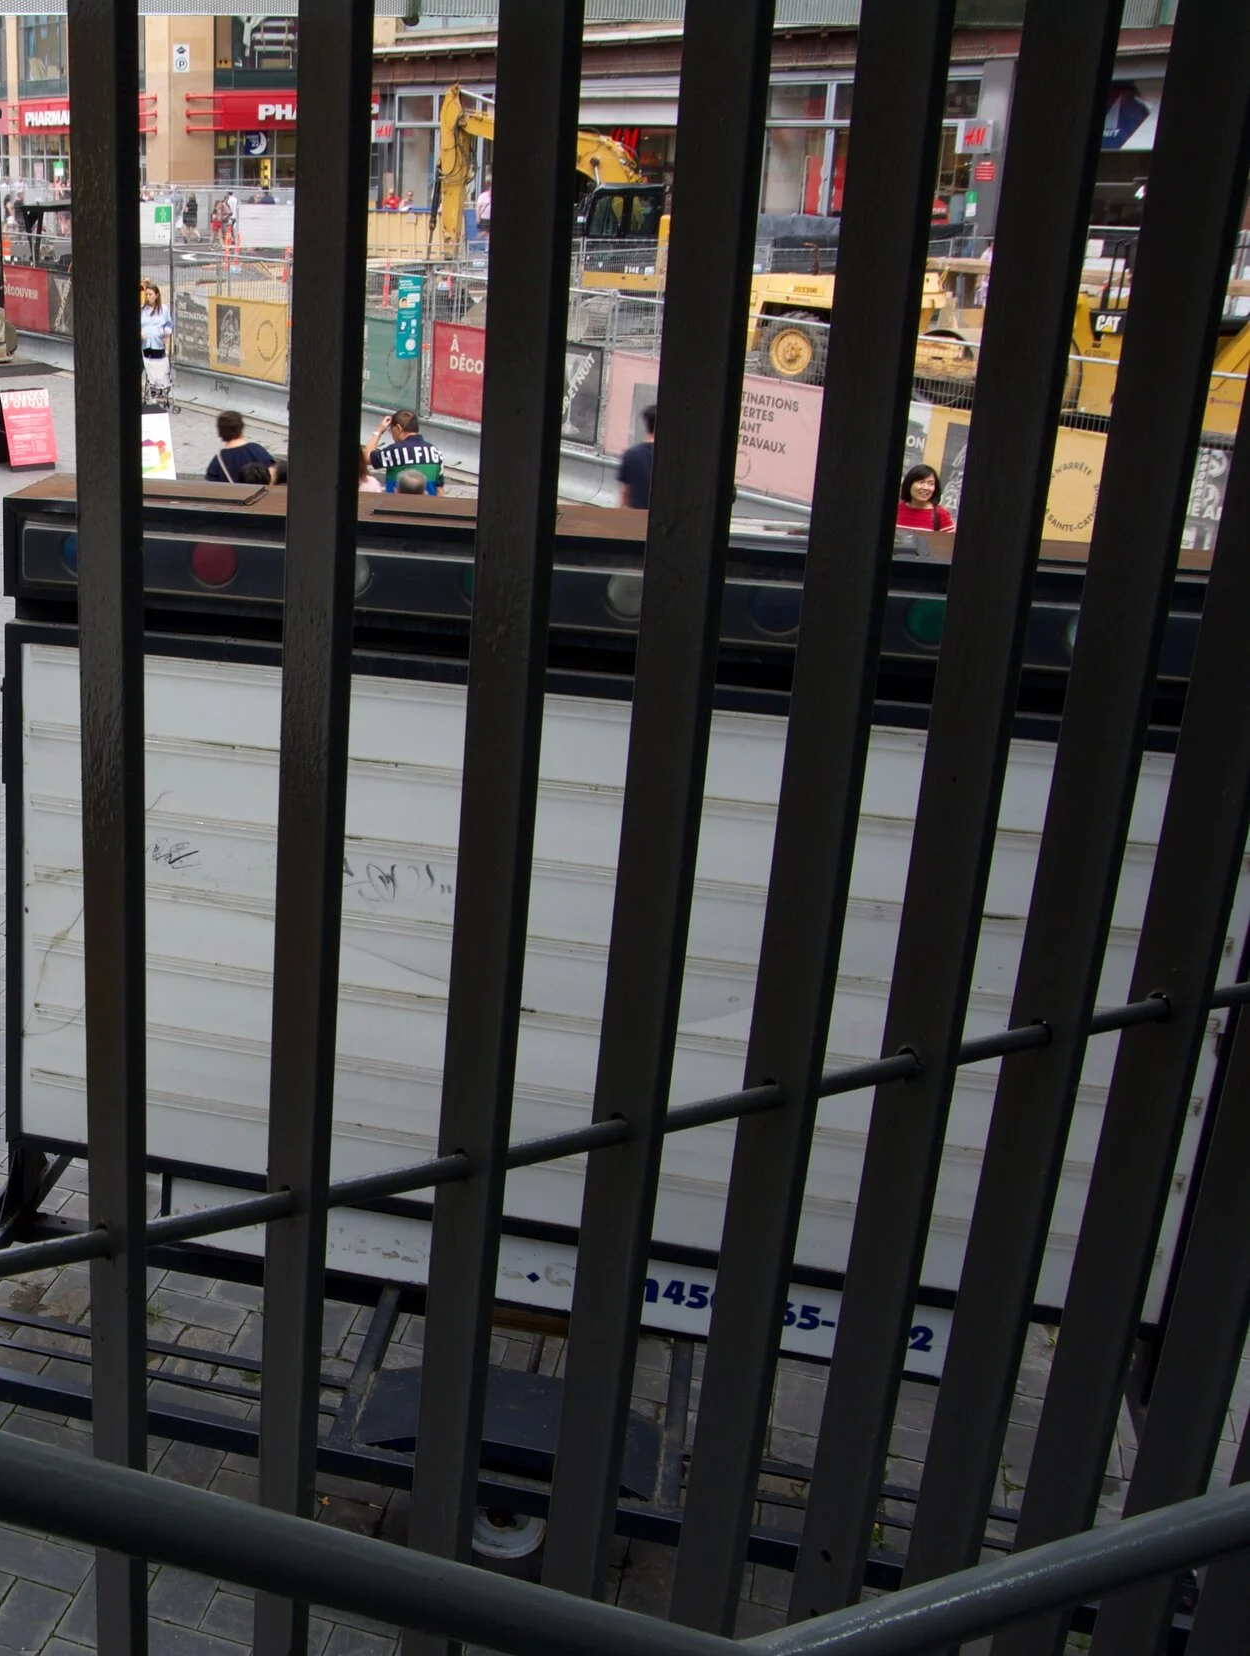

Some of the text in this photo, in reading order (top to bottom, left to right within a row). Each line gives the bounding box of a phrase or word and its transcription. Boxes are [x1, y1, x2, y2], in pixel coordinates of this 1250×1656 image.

[258, 103, 297, 121] PH
[1095, 315, 1122, 333] CAT
[741, 406, 774, 422] ERTES
[662, 1280, 715, 1310] 45
